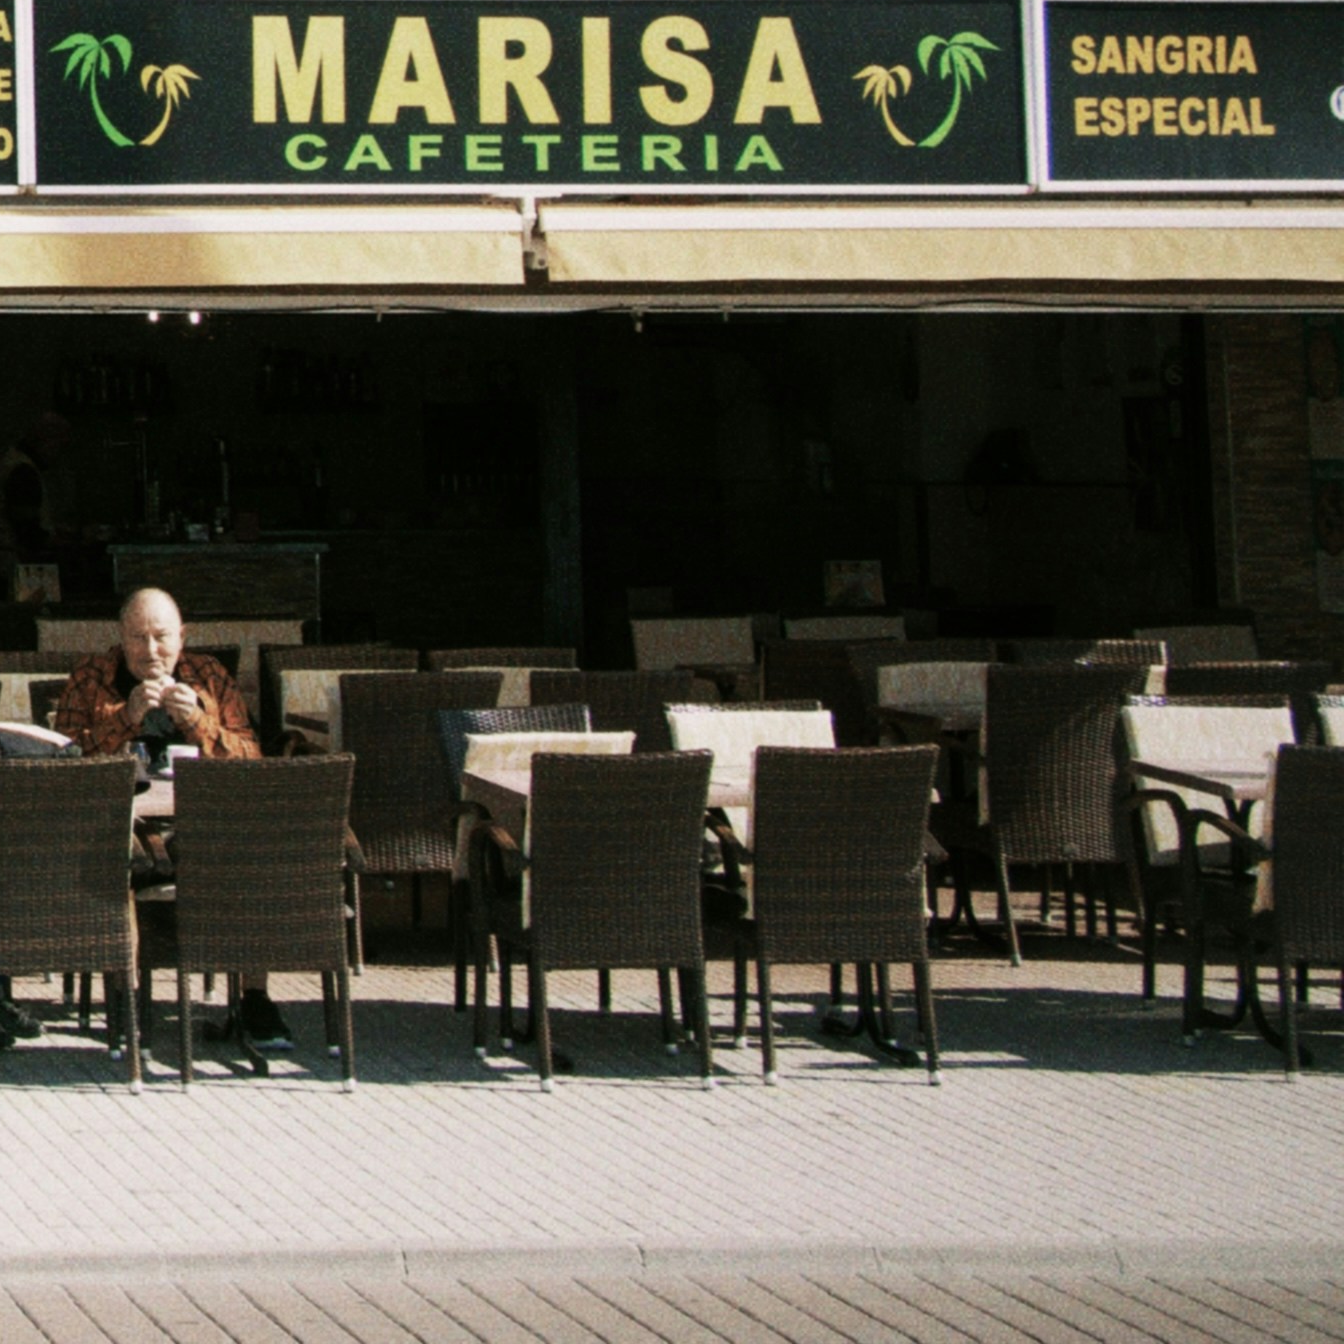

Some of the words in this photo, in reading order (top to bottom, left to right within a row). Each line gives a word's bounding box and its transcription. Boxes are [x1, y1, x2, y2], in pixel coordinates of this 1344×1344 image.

[251, 15, 824, 128] MARISA
[1071, 35, 1258, 75] SANGRIA
[1073, 97, 1277, 138] ESPECIAL
[284, 133, 785, 174] CAFETERIA
